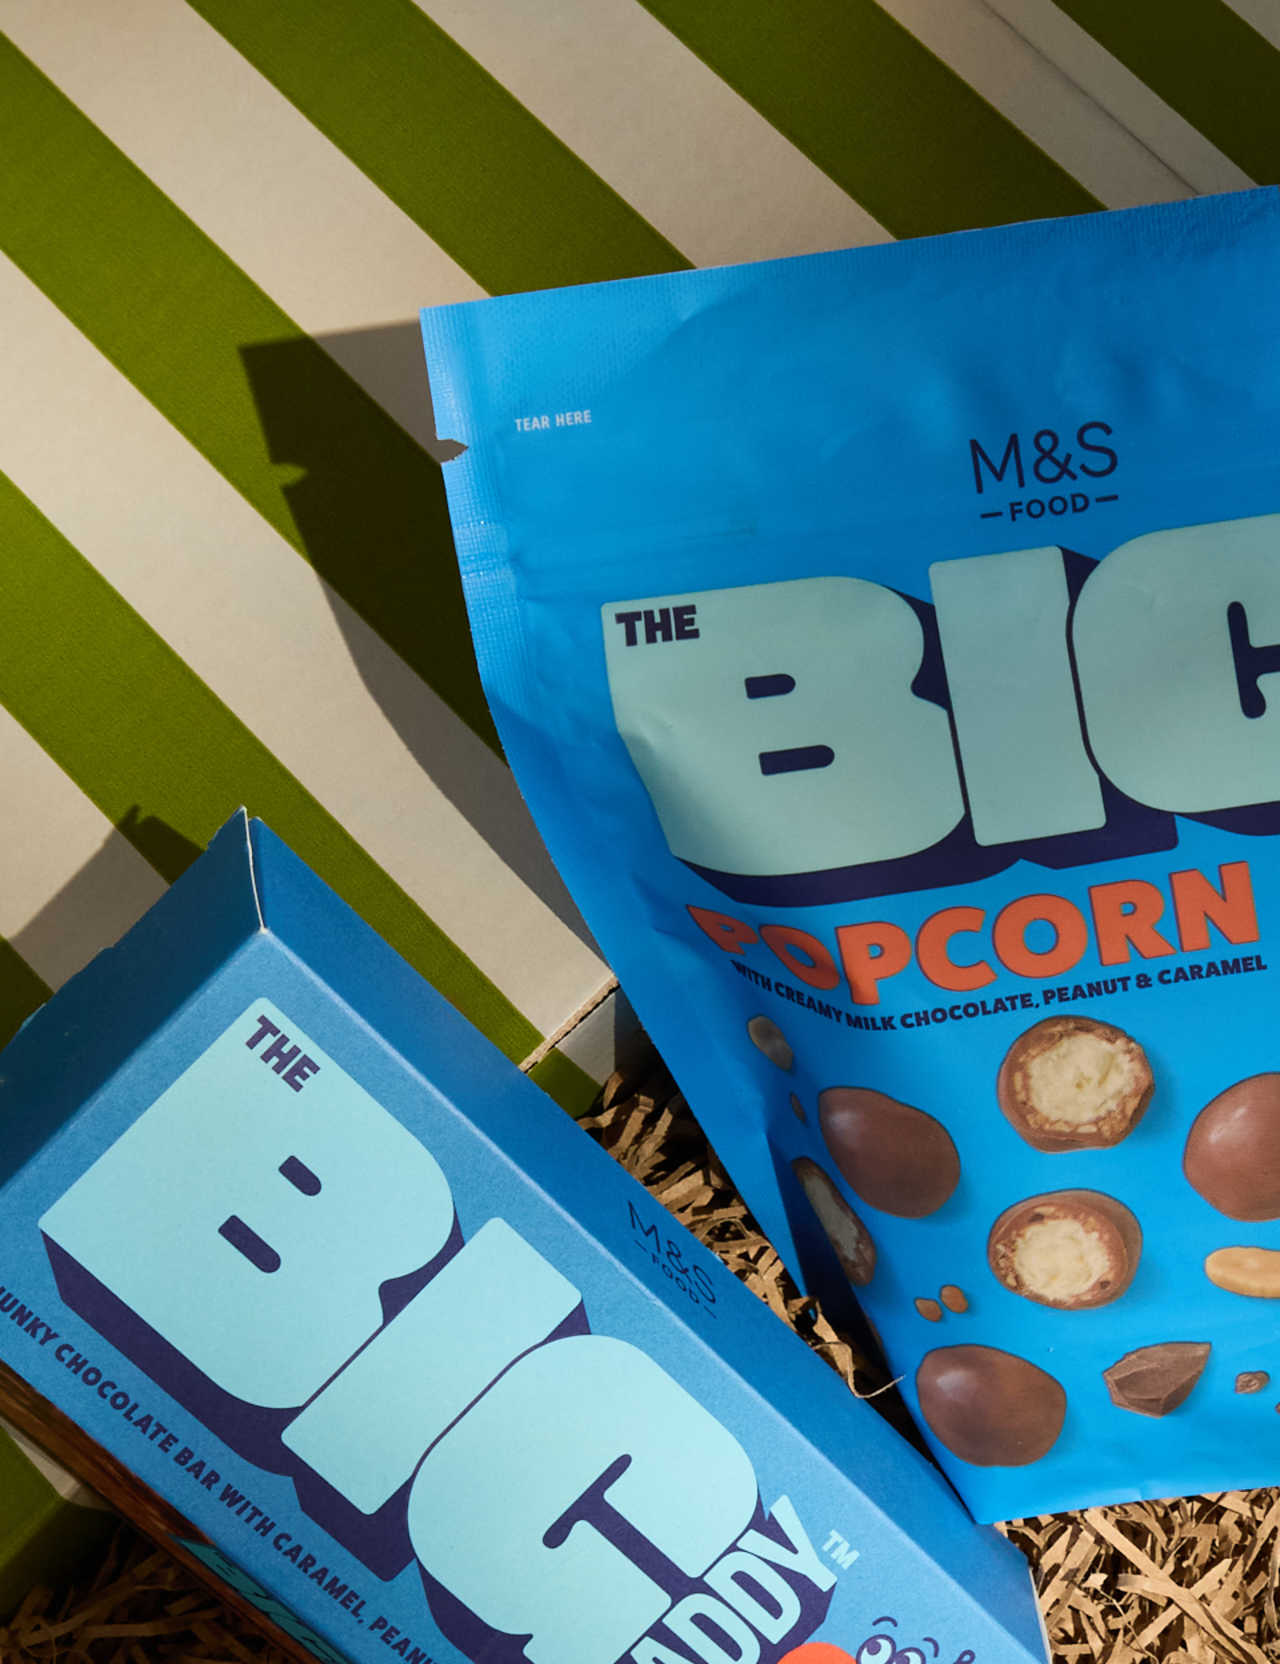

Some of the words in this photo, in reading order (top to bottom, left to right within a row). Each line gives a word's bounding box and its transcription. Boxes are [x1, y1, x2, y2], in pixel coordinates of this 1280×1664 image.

[514, 415, 550, 432] TEAR
[556, 409, 592, 427] HERE
[968, 421, 1119, 495] M&S
[1009, 491, 1090, 522] FOOD
[614, 604, 700, 647] THE
[685, 860, 1260, 1007] POPCORN
[730, 959, 772, 992] WITH
[774, 981, 843, 1023] CREAMY
[845, 1012, 898, 1031] MILK
[900, 991, 1041, 1029] CHOCOLATE,
[1043, 974, 1131, 1005] PEANUT
[1135, 973, 1153, 989] &
[1157, 955, 1268, 986] CARAMEL
[243, 1014, 321, 1093] THE
[627, 1199, 717, 1305] M&S
[0, 1286, 60, 1346] UNKY
[54, 1343, 179, 1453] CHOCOLATE
[173, 1446, 221, 1491] BAR
[218, 1483, 277, 1537] WITH
[272, 1532, 369, 1625] CARAMEL,
[821, 1528, 861, 1571] TM
